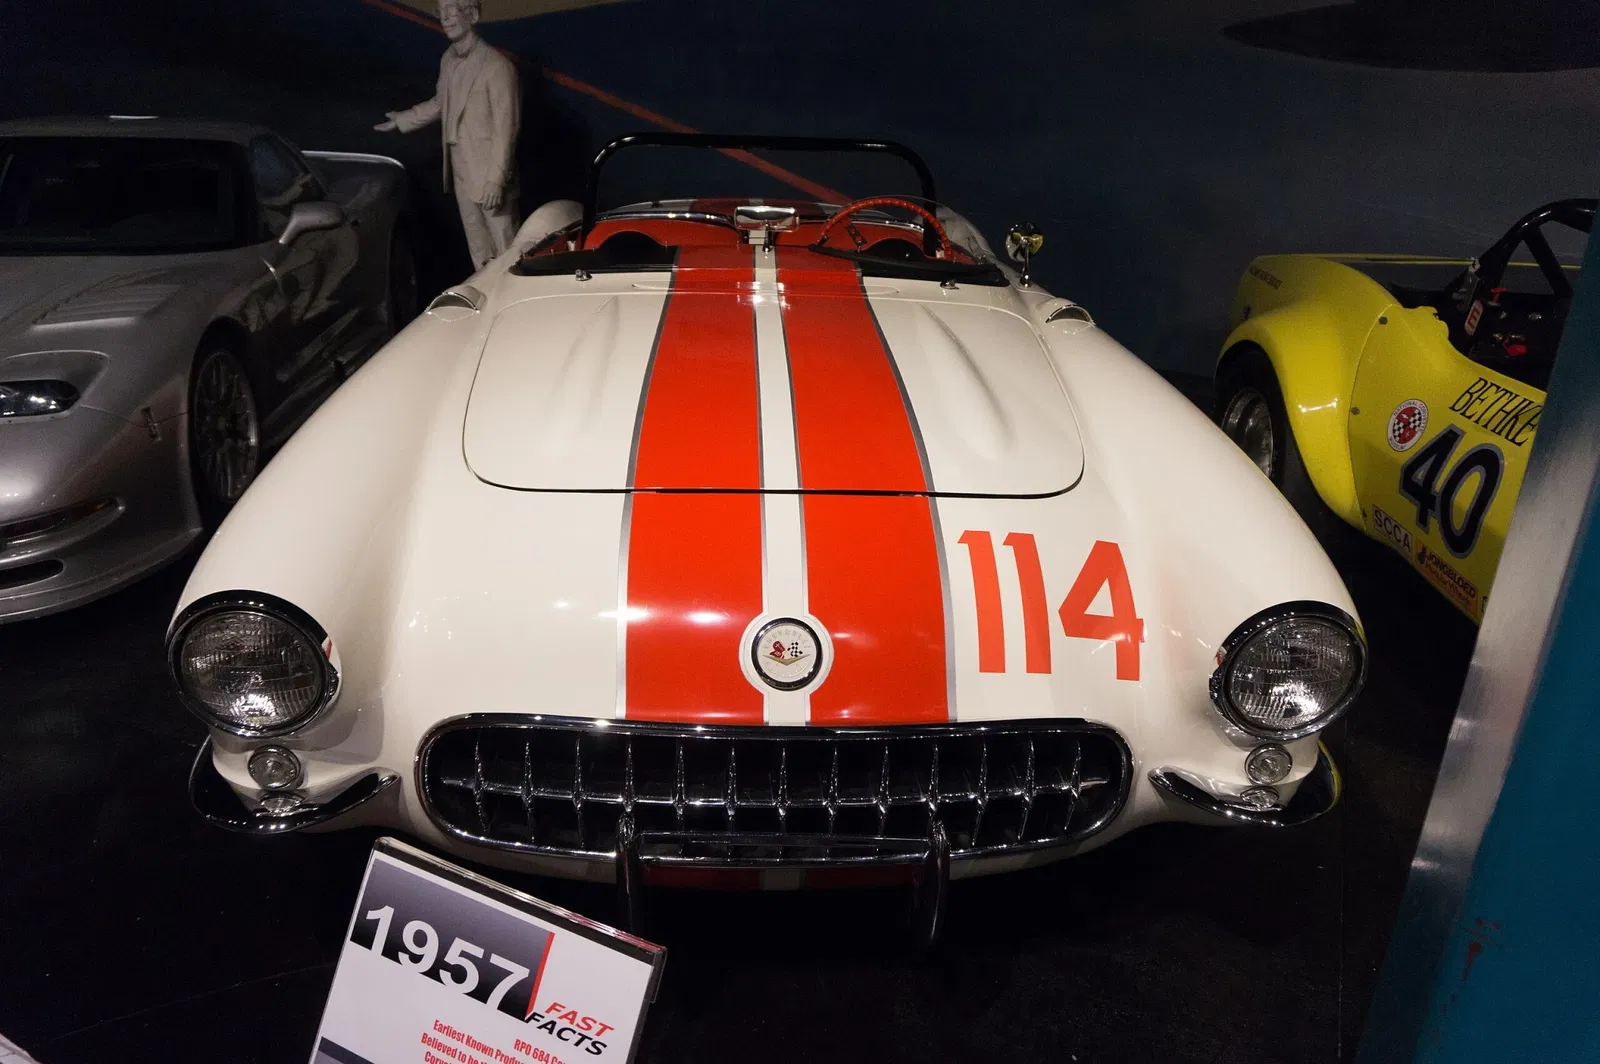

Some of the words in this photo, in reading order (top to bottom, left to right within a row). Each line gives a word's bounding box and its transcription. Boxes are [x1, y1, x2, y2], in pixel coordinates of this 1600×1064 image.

[1448, 377, 1543, 447] BETHKE
[1399, 423, 1505, 559] 40
[1374, 508, 1412, 553] SCCA
[957, 530, 1144, 681] 114
[366, 905, 530, 1009] 1957
[433, 1019, 465, 1043] Earliest
[465, 1034, 494, 1058] Known
[525, 1012, 608, 1055] FACTS
[545, 1002, 614, 1037] FAST
[421, 1032, 458, 1059] Believed
[458, 1051, 467, 1063] to
[514, 1039, 532, 1056] RPO
[532, 1048, 550, 1064] 684
